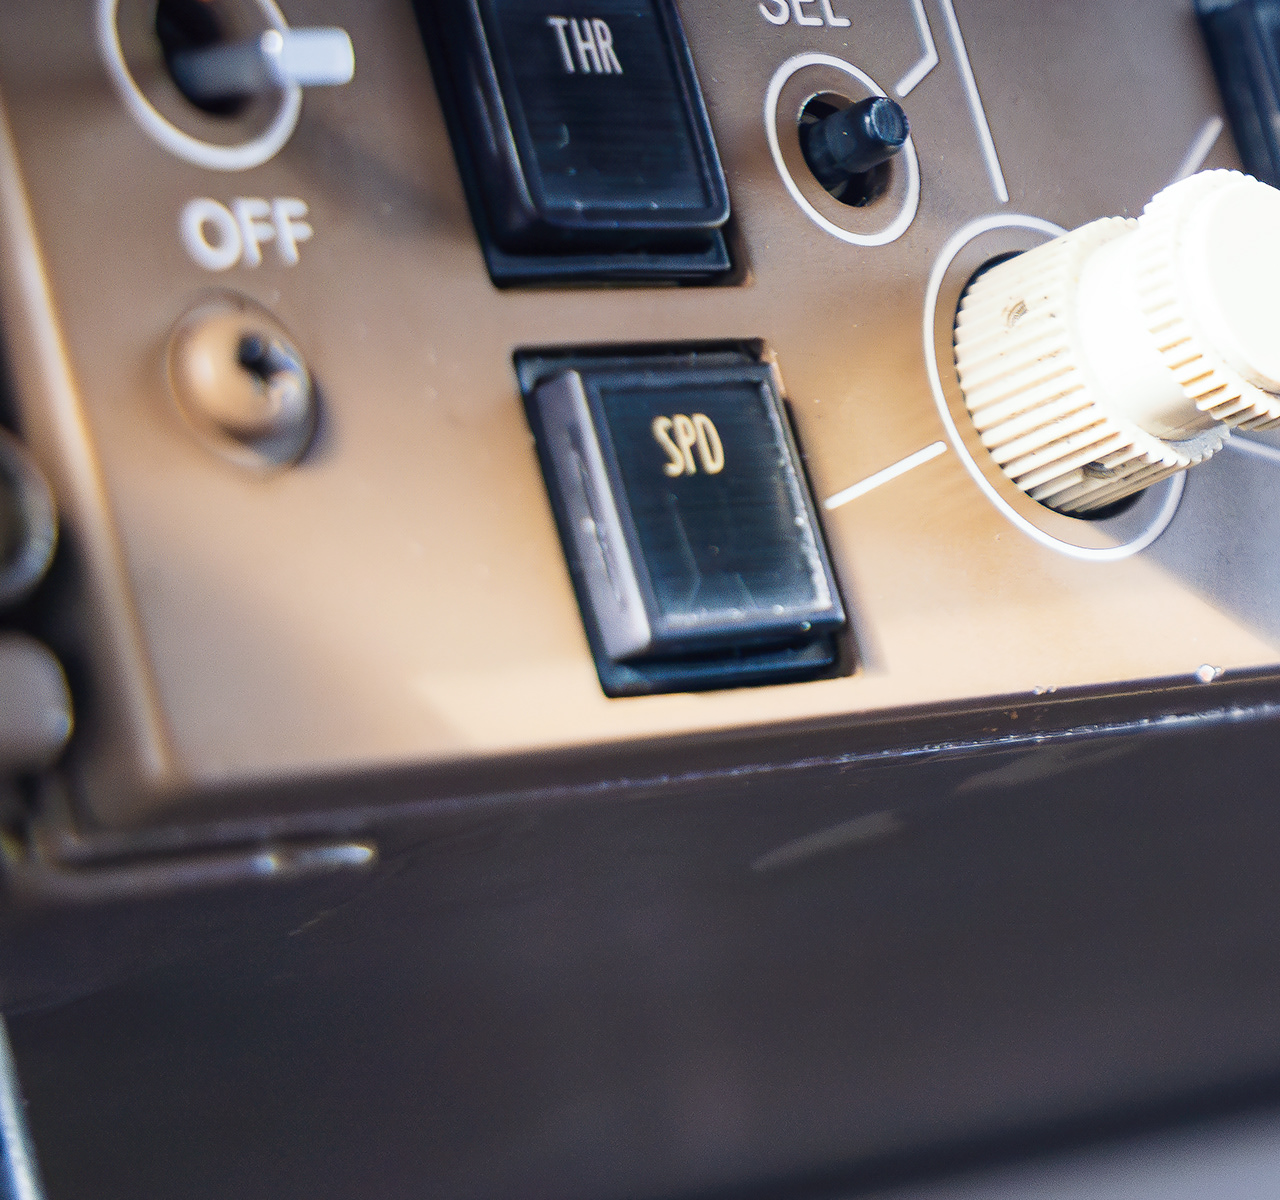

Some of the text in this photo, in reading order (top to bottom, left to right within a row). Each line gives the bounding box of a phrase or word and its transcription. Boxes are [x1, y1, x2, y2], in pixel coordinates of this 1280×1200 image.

[547, 15, 623, 75] THR
[180, 197, 313, 270] OFF
[651, 412, 725, 476] SPD
